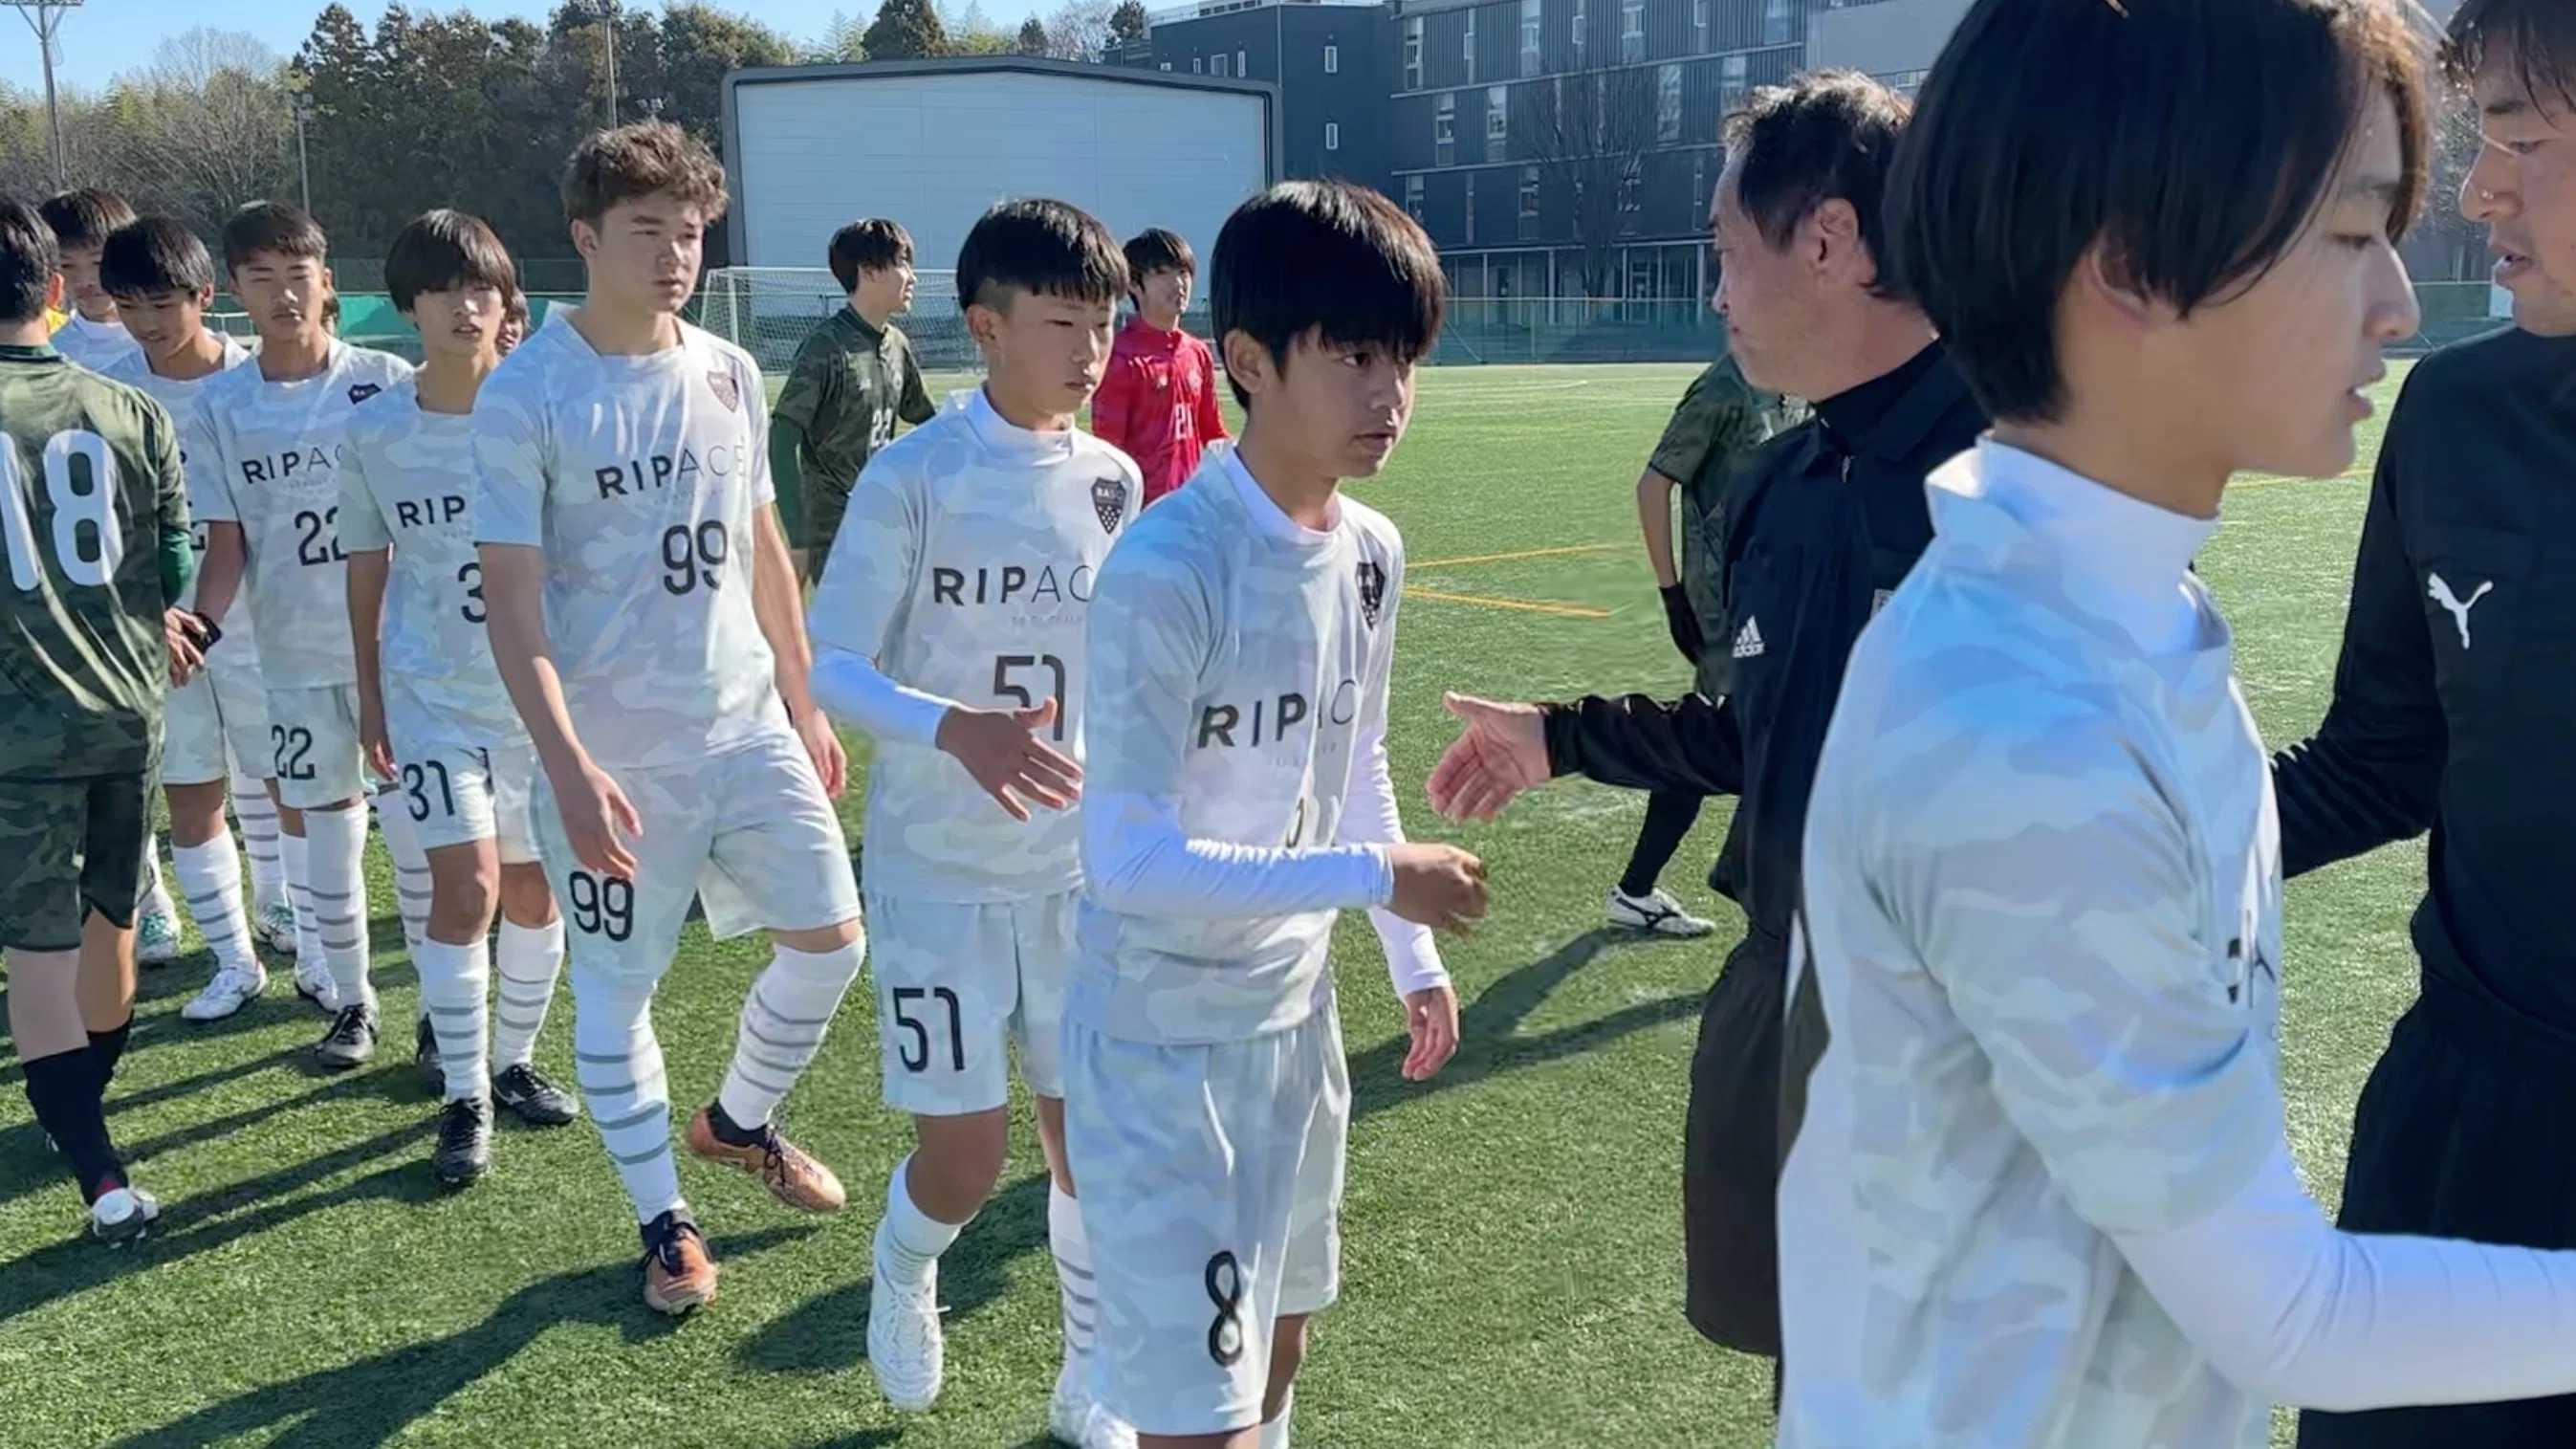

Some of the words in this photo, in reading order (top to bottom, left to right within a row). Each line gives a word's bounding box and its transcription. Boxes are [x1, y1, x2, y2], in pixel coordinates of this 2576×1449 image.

[0, 428, 124, 591] 18
[663, 520, 728, 595] 99
[1197, 679, 1356, 749] RIPC
[272, 724, 316, 779] 22
[569, 871, 634, 942] 99
[1206, 1250, 1243, 1368] 8
